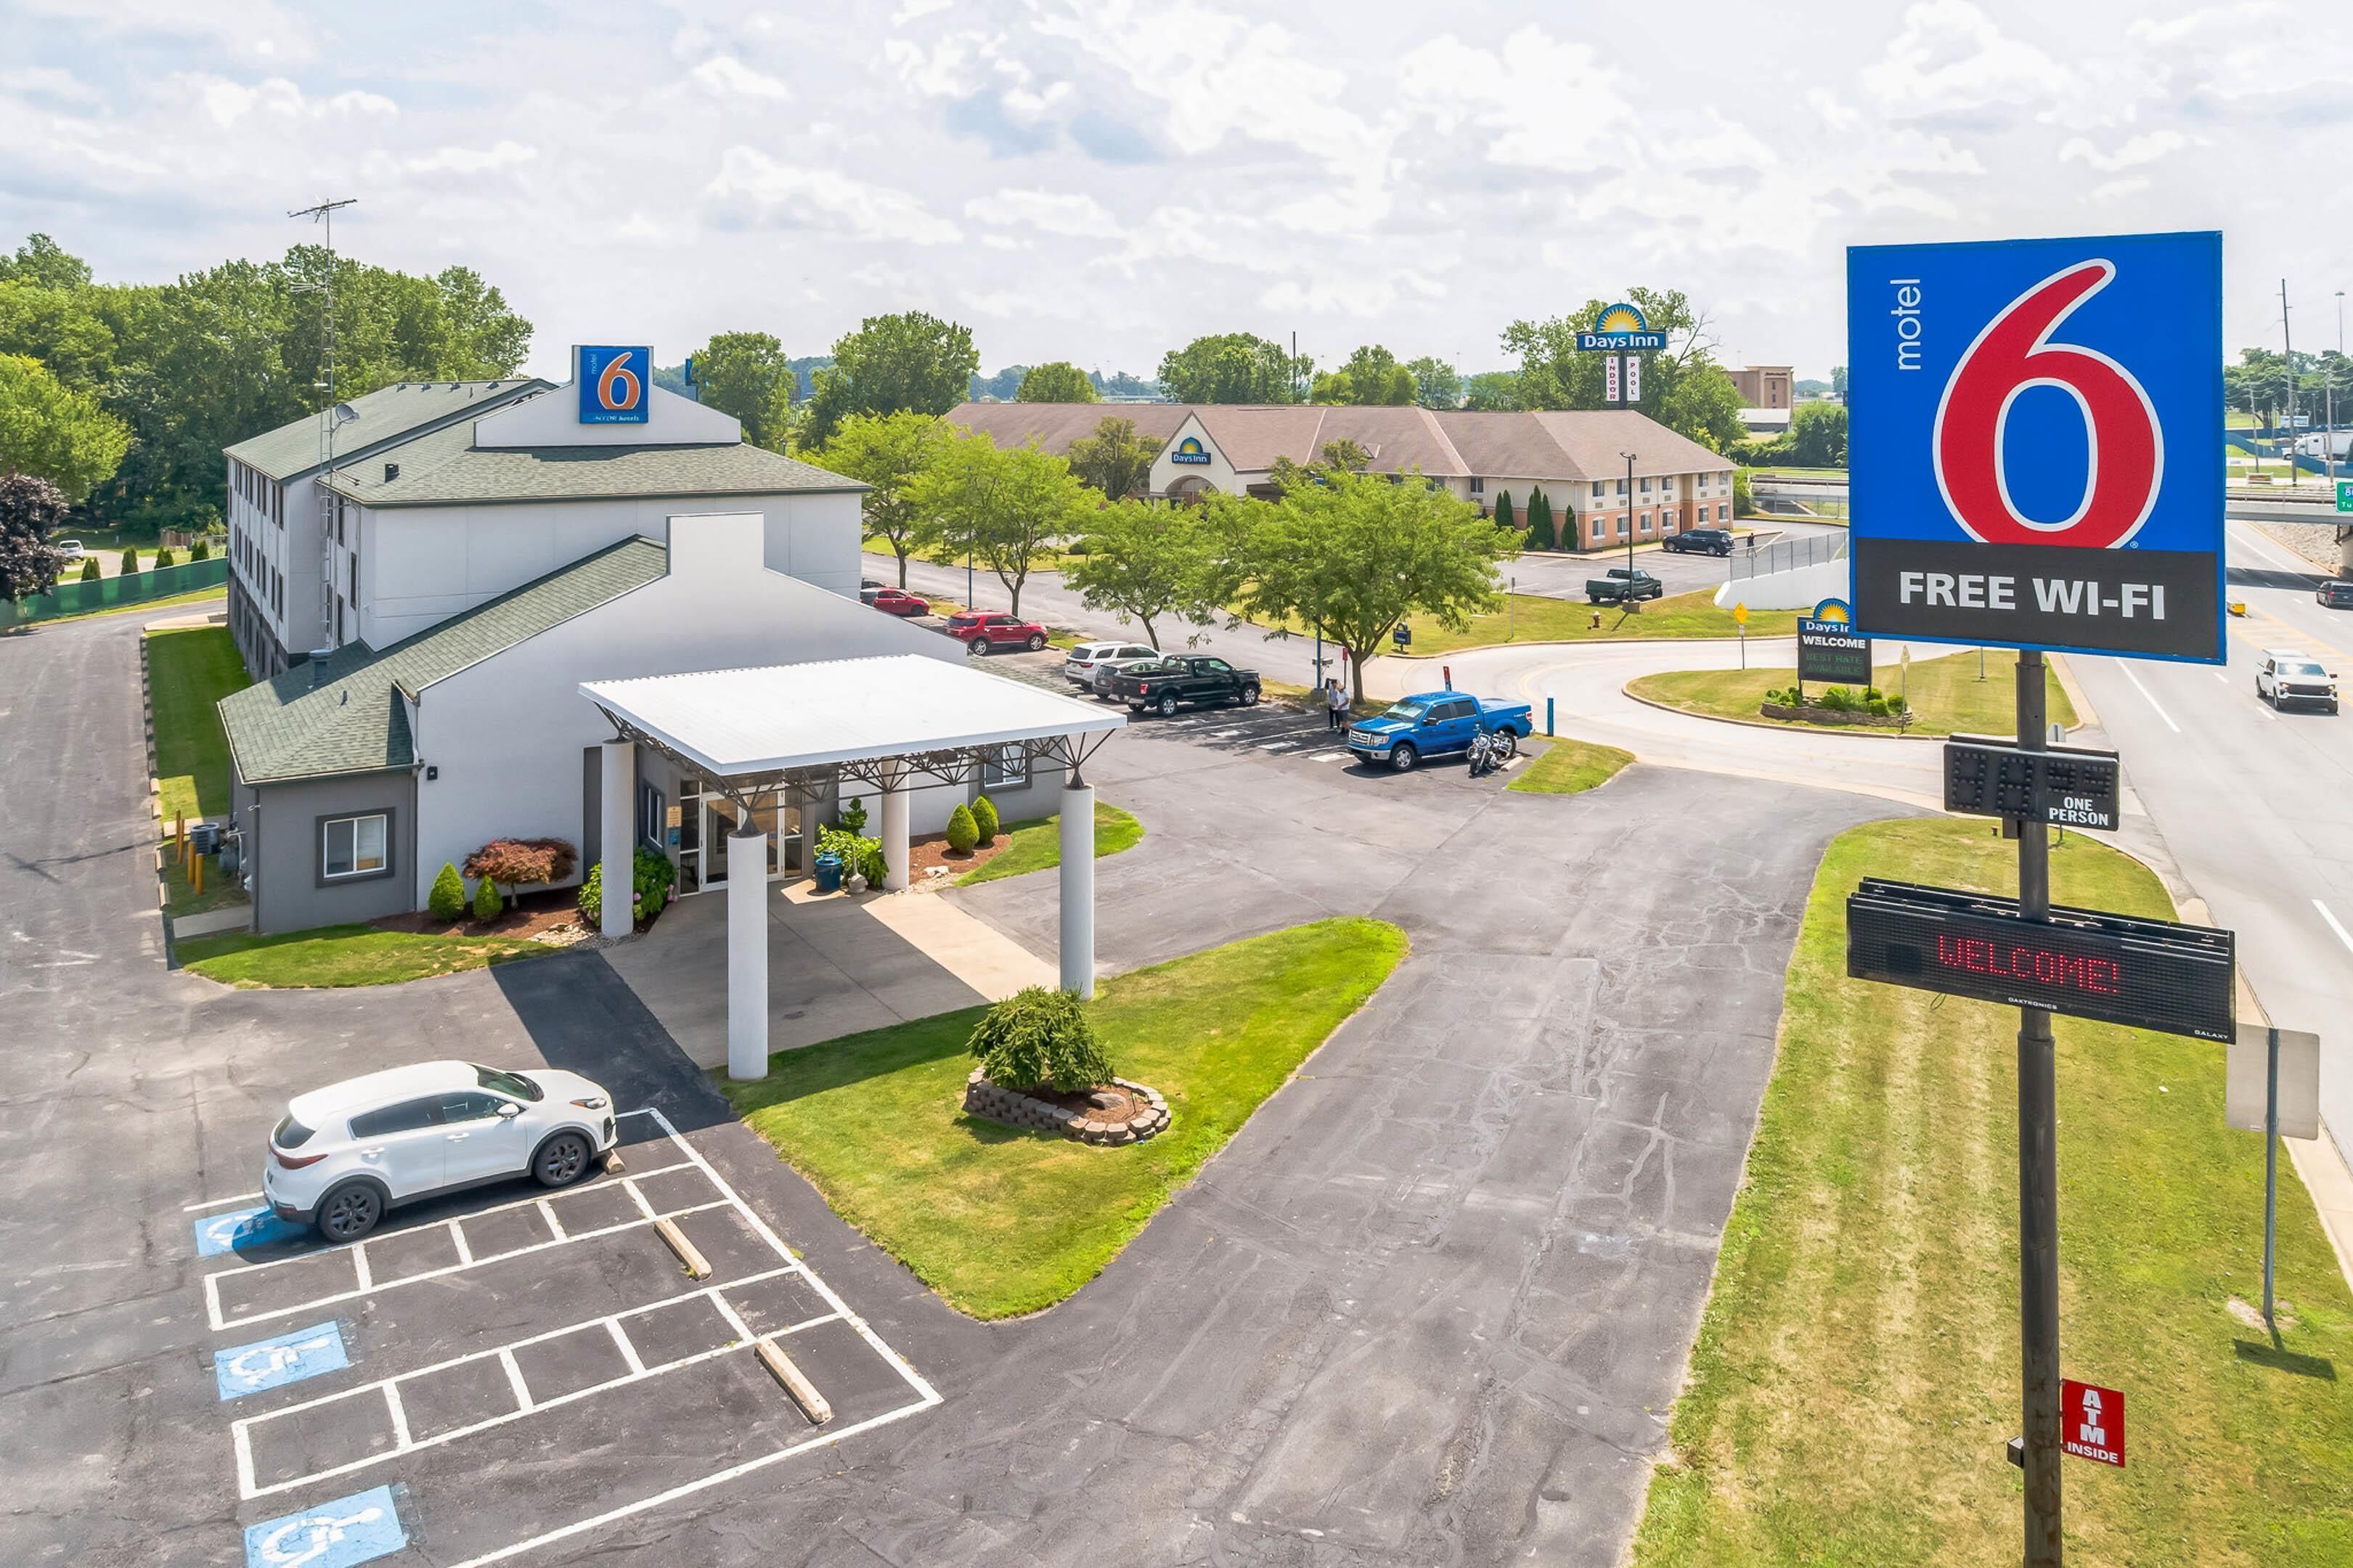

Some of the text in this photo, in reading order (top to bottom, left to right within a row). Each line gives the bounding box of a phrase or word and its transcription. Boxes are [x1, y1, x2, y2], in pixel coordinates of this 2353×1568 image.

[1584, 335, 1659, 349] Days Inn
[598, 351, 641, 410] 6
[1890, 258, 2165, 550] motel 6
[1173, 454, 1193, 462] Days
[1899, 571, 2165, 620] FREE WI-FI
[1806, 621, 1838, 633] Days
[1802, 634, 1866, 649] WELCOME
[1835, 655, 1862, 664] RATE
[2063, 796, 2093, 812] ONE
[2049, 807, 2109, 826] PERSON
[1938, 934, 2118, 994] WELCOME!
[2194, 1029, 2229, 1040] GALAXY
[2080, 1388, 2105, 1446] ATM
[2067, 1441, 2118, 1463] INSIDE
